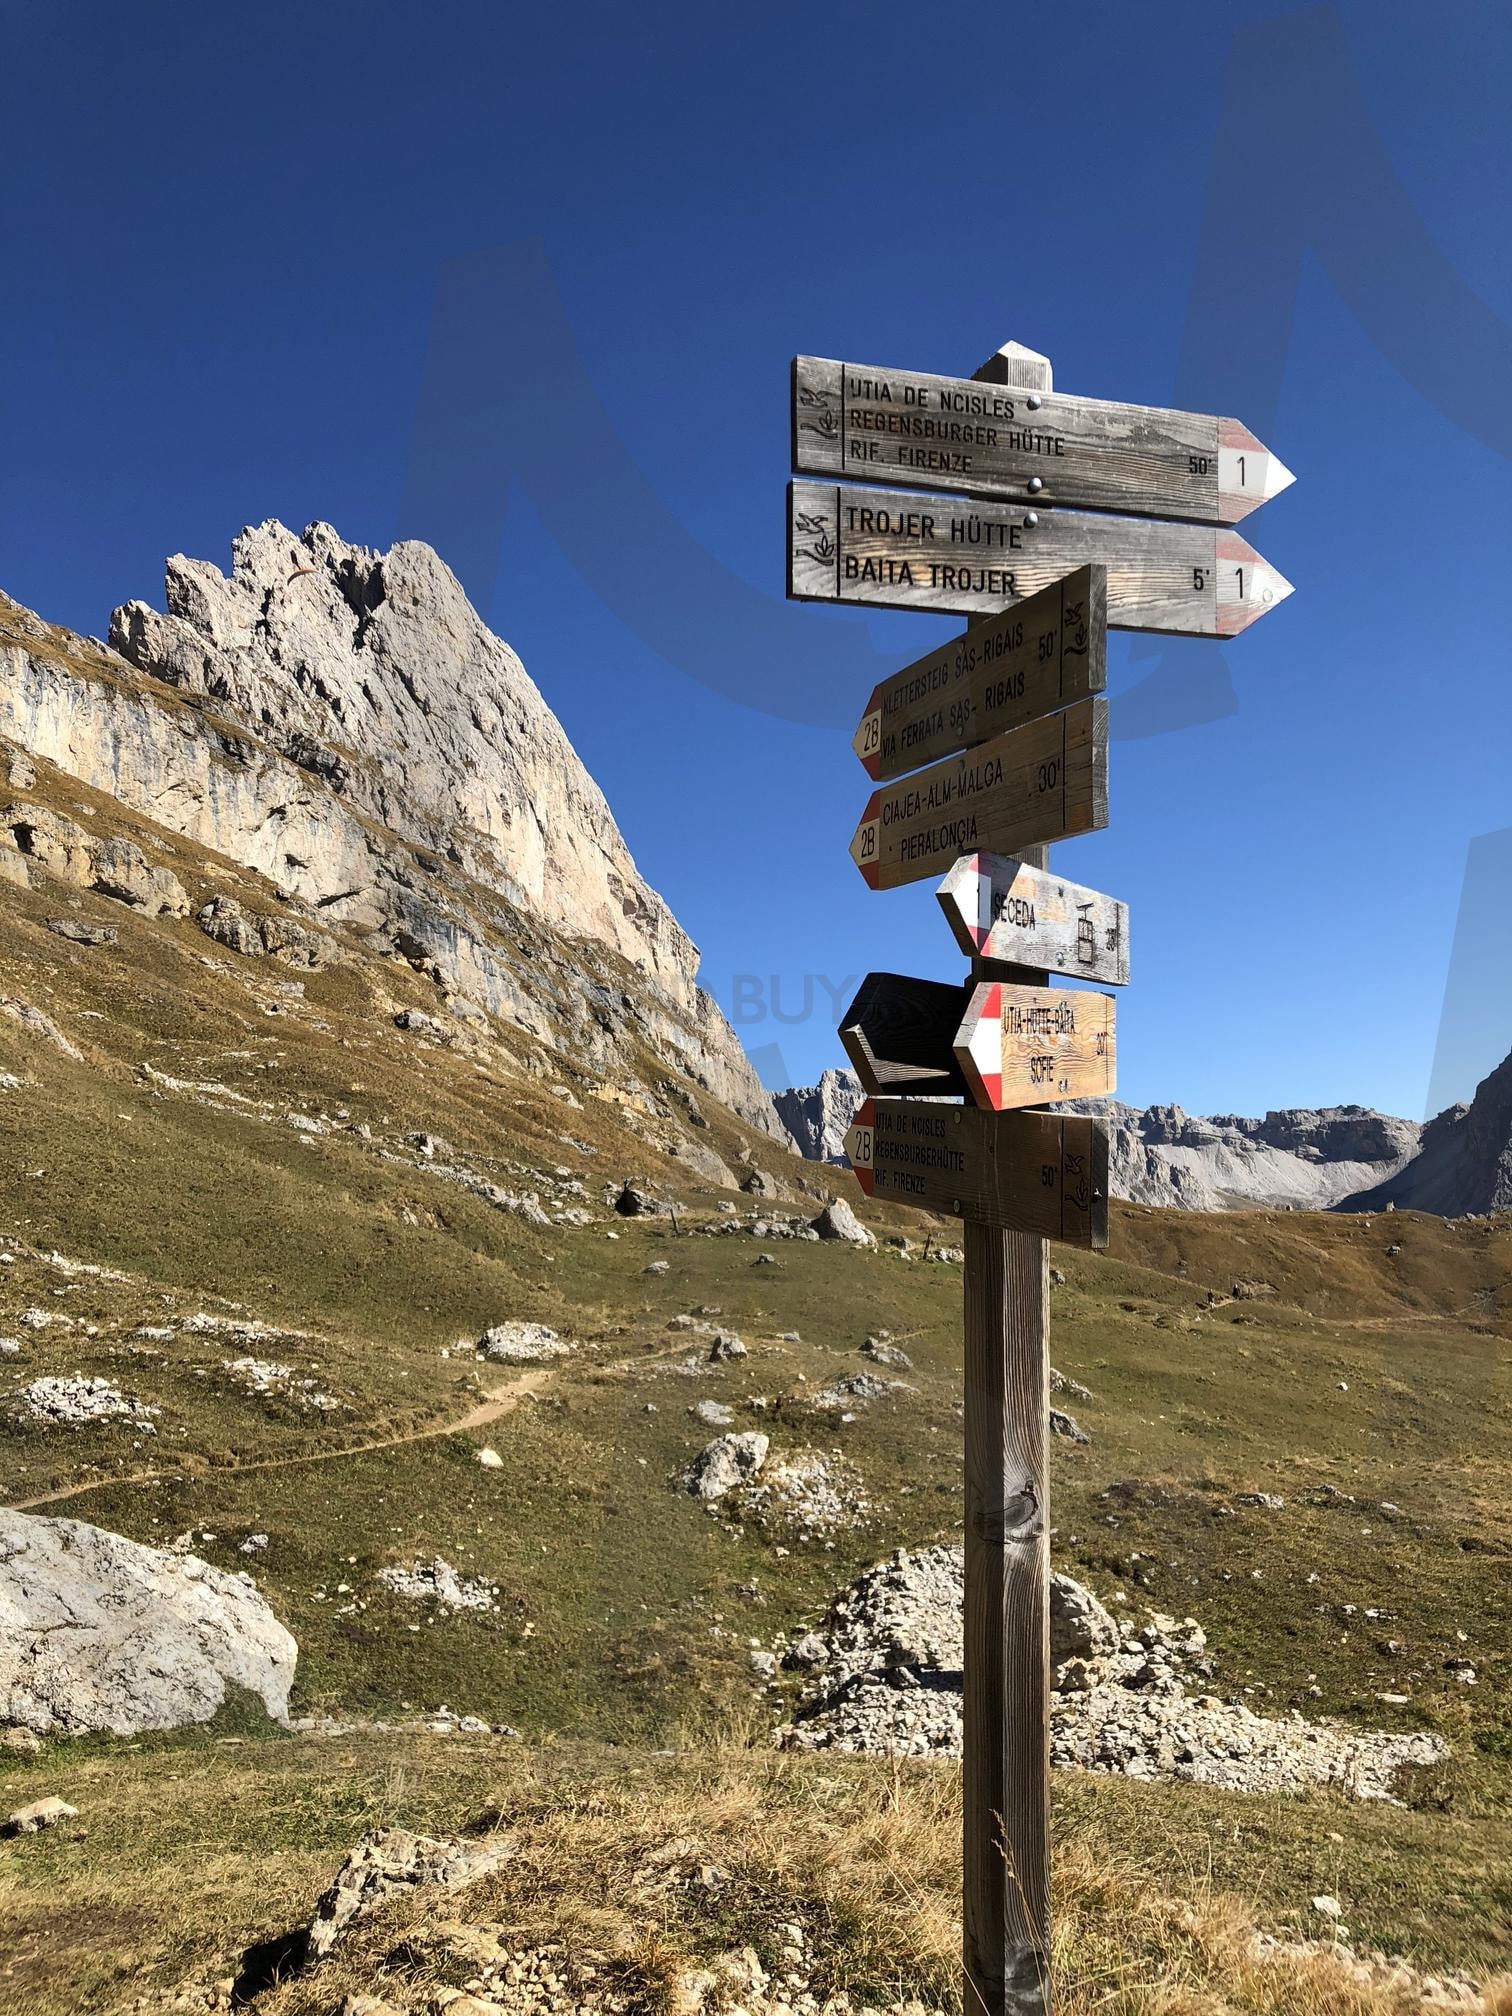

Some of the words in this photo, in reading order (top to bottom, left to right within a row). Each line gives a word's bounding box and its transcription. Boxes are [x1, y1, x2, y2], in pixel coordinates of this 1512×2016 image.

[850, 378, 892, 403] UTIA
[904, 386, 930, 408] DE
[940, 391, 1015, 420] NCISLES
[849, 411, 998, 447] REGENSBURGER
[1009, 430, 1066, 457] HÜTTE
[850, 440, 885, 464] RIF.
[899, 448, 973, 474] FIRENZE
[1236, 456, 1247, 488] 1
[845, 507, 936, 541] TROJER
[951, 513, 1023, 549] HÜTTE
[844, 556, 914, 588] BAITA
[928, 563, 1016, 596] TROJER
[1235, 566, 1245, 600] 1
[883, 663, 949, 718] KLETTERSTEIG
[882, 735, 896, 760] VIA
[901, 711, 945, 748] FERRATA
[984, 671, 1026, 711] RIGAIS
[863, 718, 880, 753] 2B
[860, 826, 876, 859] 2B
[994, 891, 1036, 931] SECEDA
[1030, 1055, 1054, 1083] SOFIE
[876, 1111, 893, 1132] UTIA
[896, 1115, 907, 1134] DE
[911, 1117, 946, 1138] NCISLES
[855, 1131, 871, 1162] 2B
[875, 1135, 965, 1172] REGENSBURGERHÜTTE
[875, 1168, 889, 1186] RIF.
[894, 1171, 927, 1195] FIRENZE
